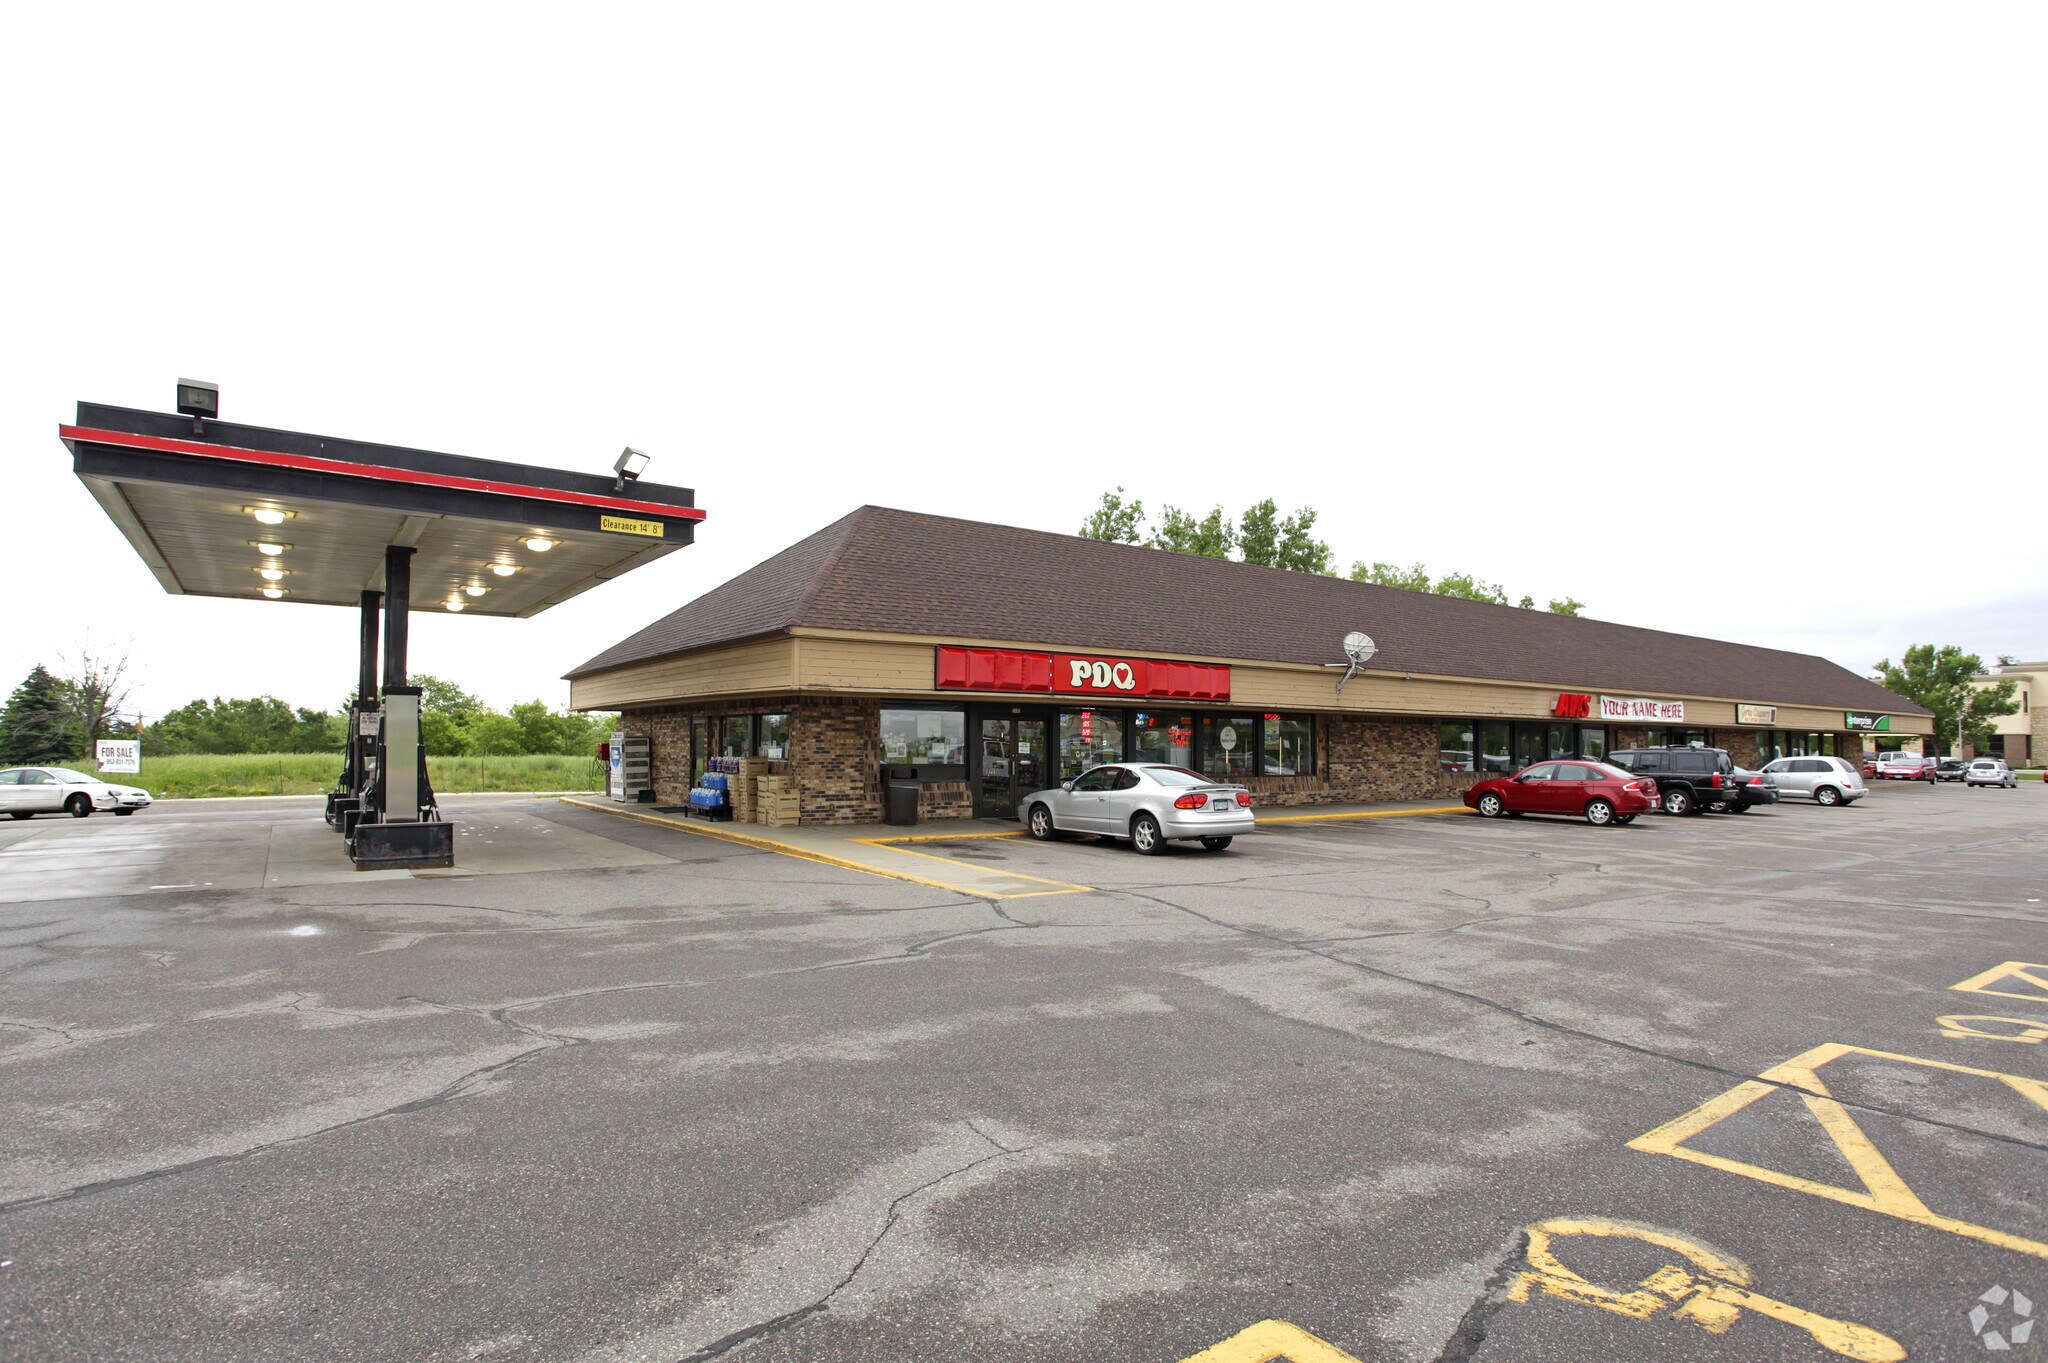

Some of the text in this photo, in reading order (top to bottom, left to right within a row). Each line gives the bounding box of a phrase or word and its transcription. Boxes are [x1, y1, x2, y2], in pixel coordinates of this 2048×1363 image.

[602, 518, 637, 532] Clearance
[1069, 660, 1136, 690] PDQ
[1554, 693, 1592, 718] AVIS
[1602, 699, 1683, 718] YOUR NAME HERE
[1846, 716, 1873, 728] enterprise
[101, 747, 133, 758] FOR SALE
